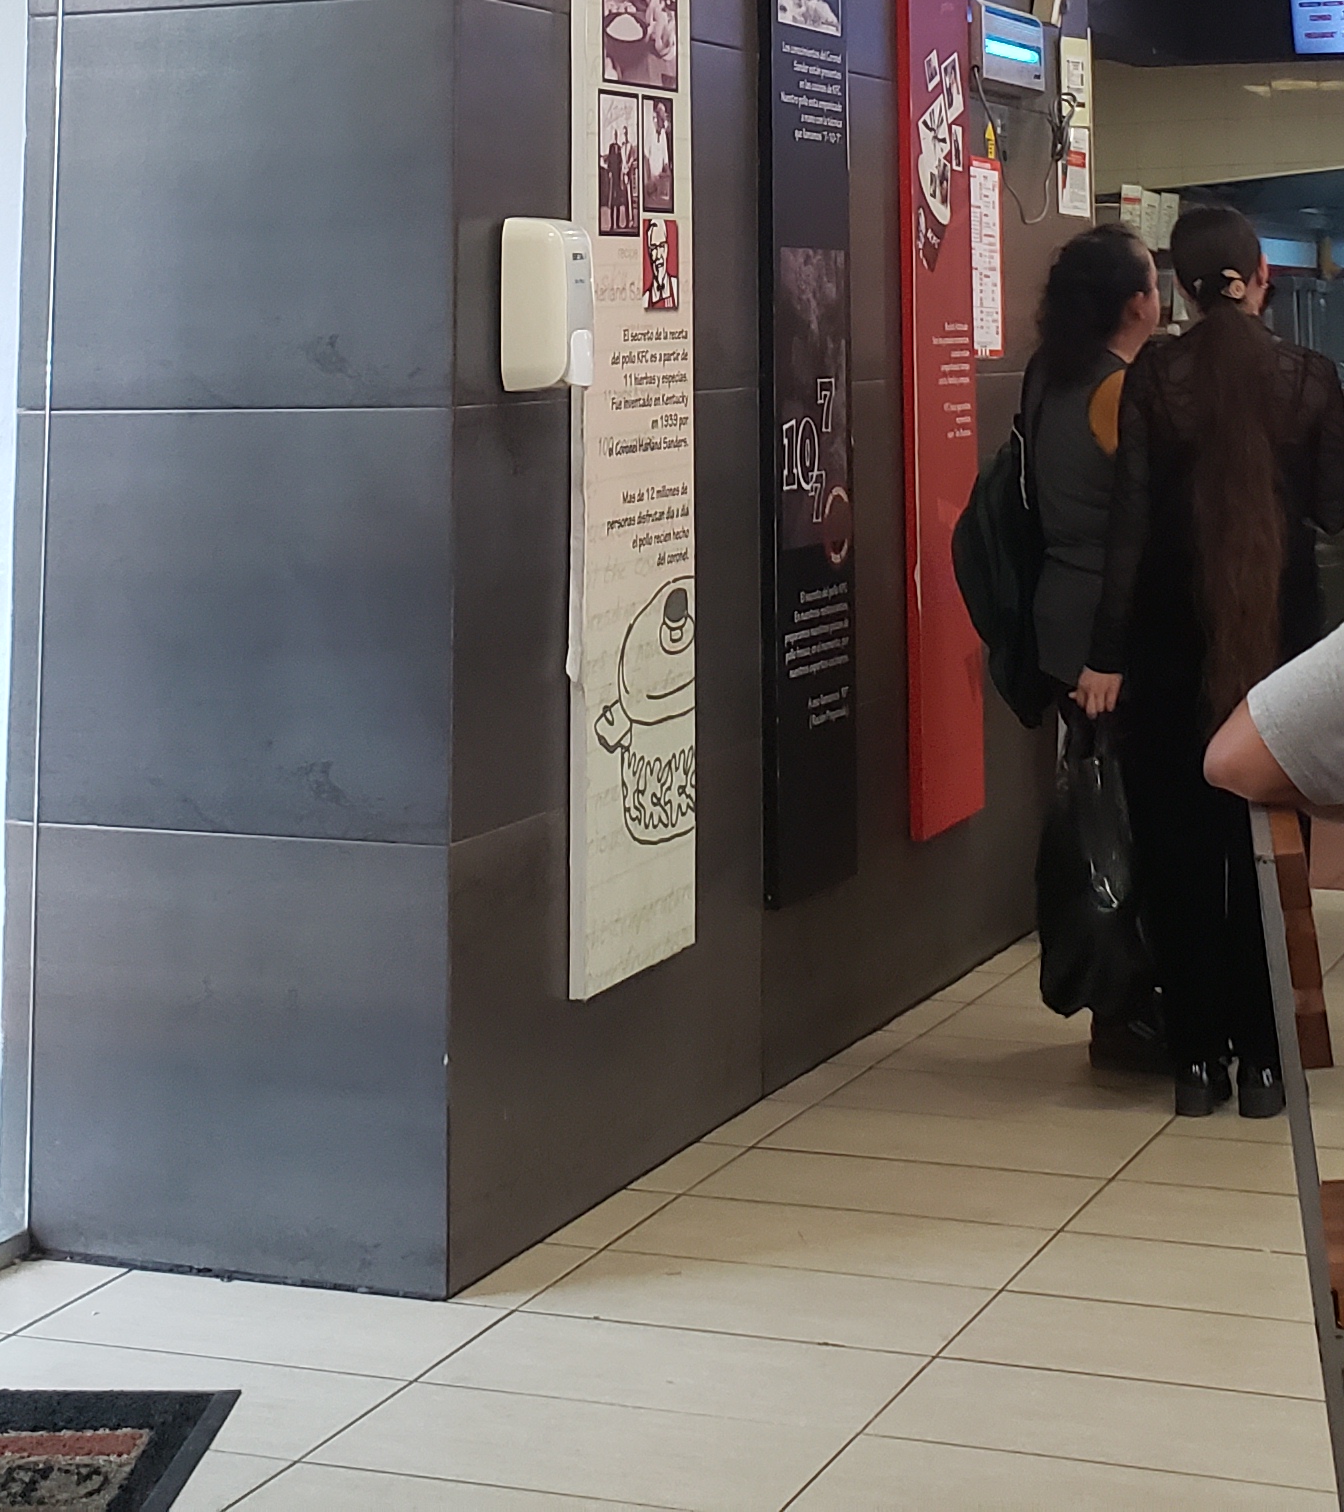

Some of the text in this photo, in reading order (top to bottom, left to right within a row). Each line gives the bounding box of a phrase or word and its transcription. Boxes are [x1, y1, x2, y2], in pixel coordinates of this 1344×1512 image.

[622, 327, 688, 343] El secreto de la receta
[611, 351, 621, 366] del
[621, 351, 636, 370] pollo
[636, 349, 649, 364] KFC
[650, 353, 657, 363] es
[662, 349, 680, 368] partir
[680, 348, 688, 361] de
[624, 373, 633, 387] 11
[633, 372, 656, 386] hierbas
[611, 396, 622, 410] Fue
[662, 390, 688, 408] Kentucky
[817, 378, 835, 433] 7
[660, 412, 678, 429] 1939
[678, 416, 689, 431] por
[782, 416, 819, 491] 10
[636, 488, 645, 503] de
[646, 486, 655, 501] 12
[656, 485, 680, 499] millones
[680, 482, 688, 496] de
[808, 470, 826, 523] 7
[606, 515, 636, 537] personas
[638, 533, 653, 553] pollo
[672, 526, 690, 541] hecho
[656, 551, 666, 567] del
